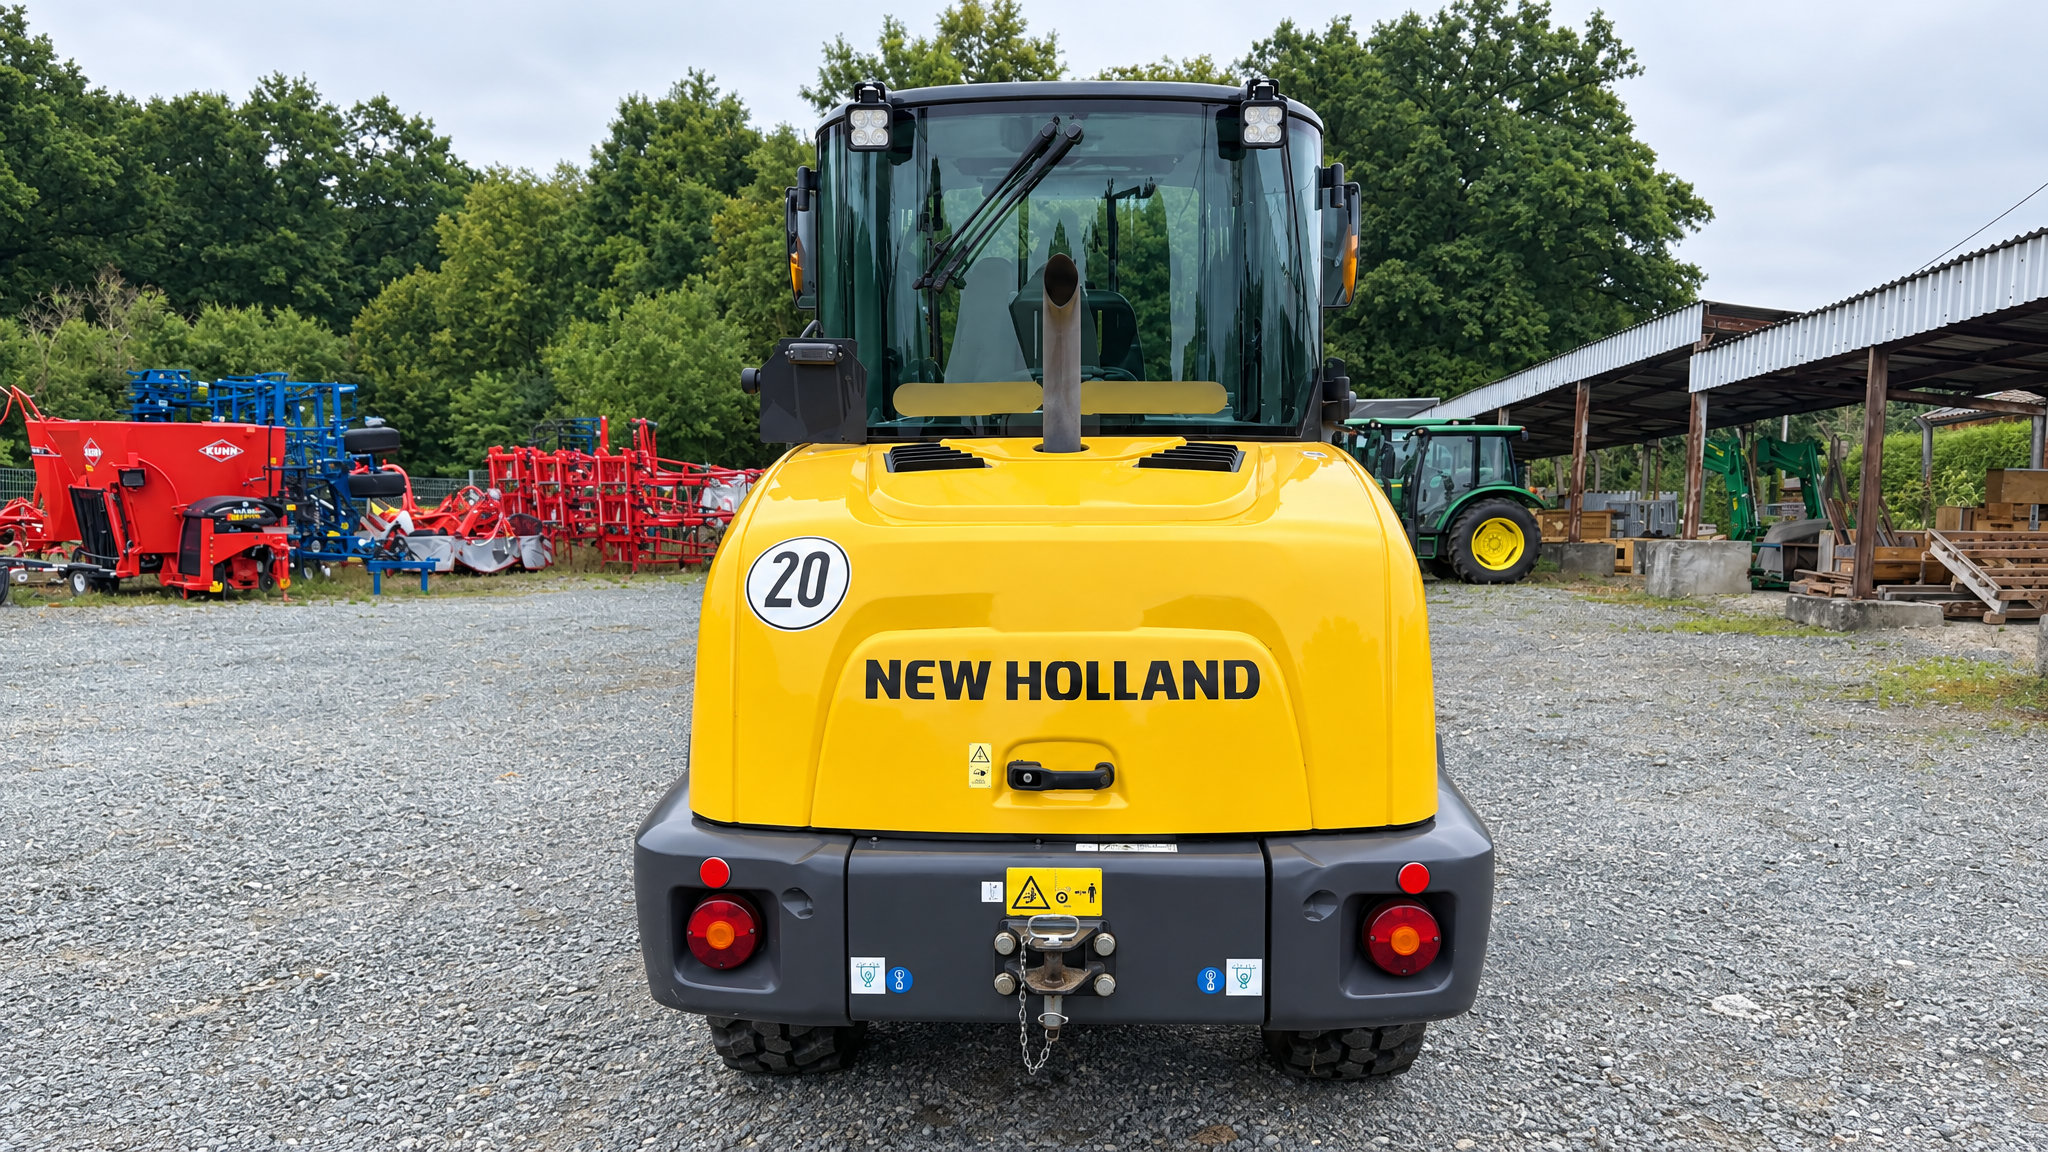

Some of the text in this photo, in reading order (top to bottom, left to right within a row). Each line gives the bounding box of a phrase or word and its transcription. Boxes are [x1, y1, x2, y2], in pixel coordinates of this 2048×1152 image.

[764, 551, 830, 608] 20
[865, 659, 1261, 701] NEW HOLLAND
